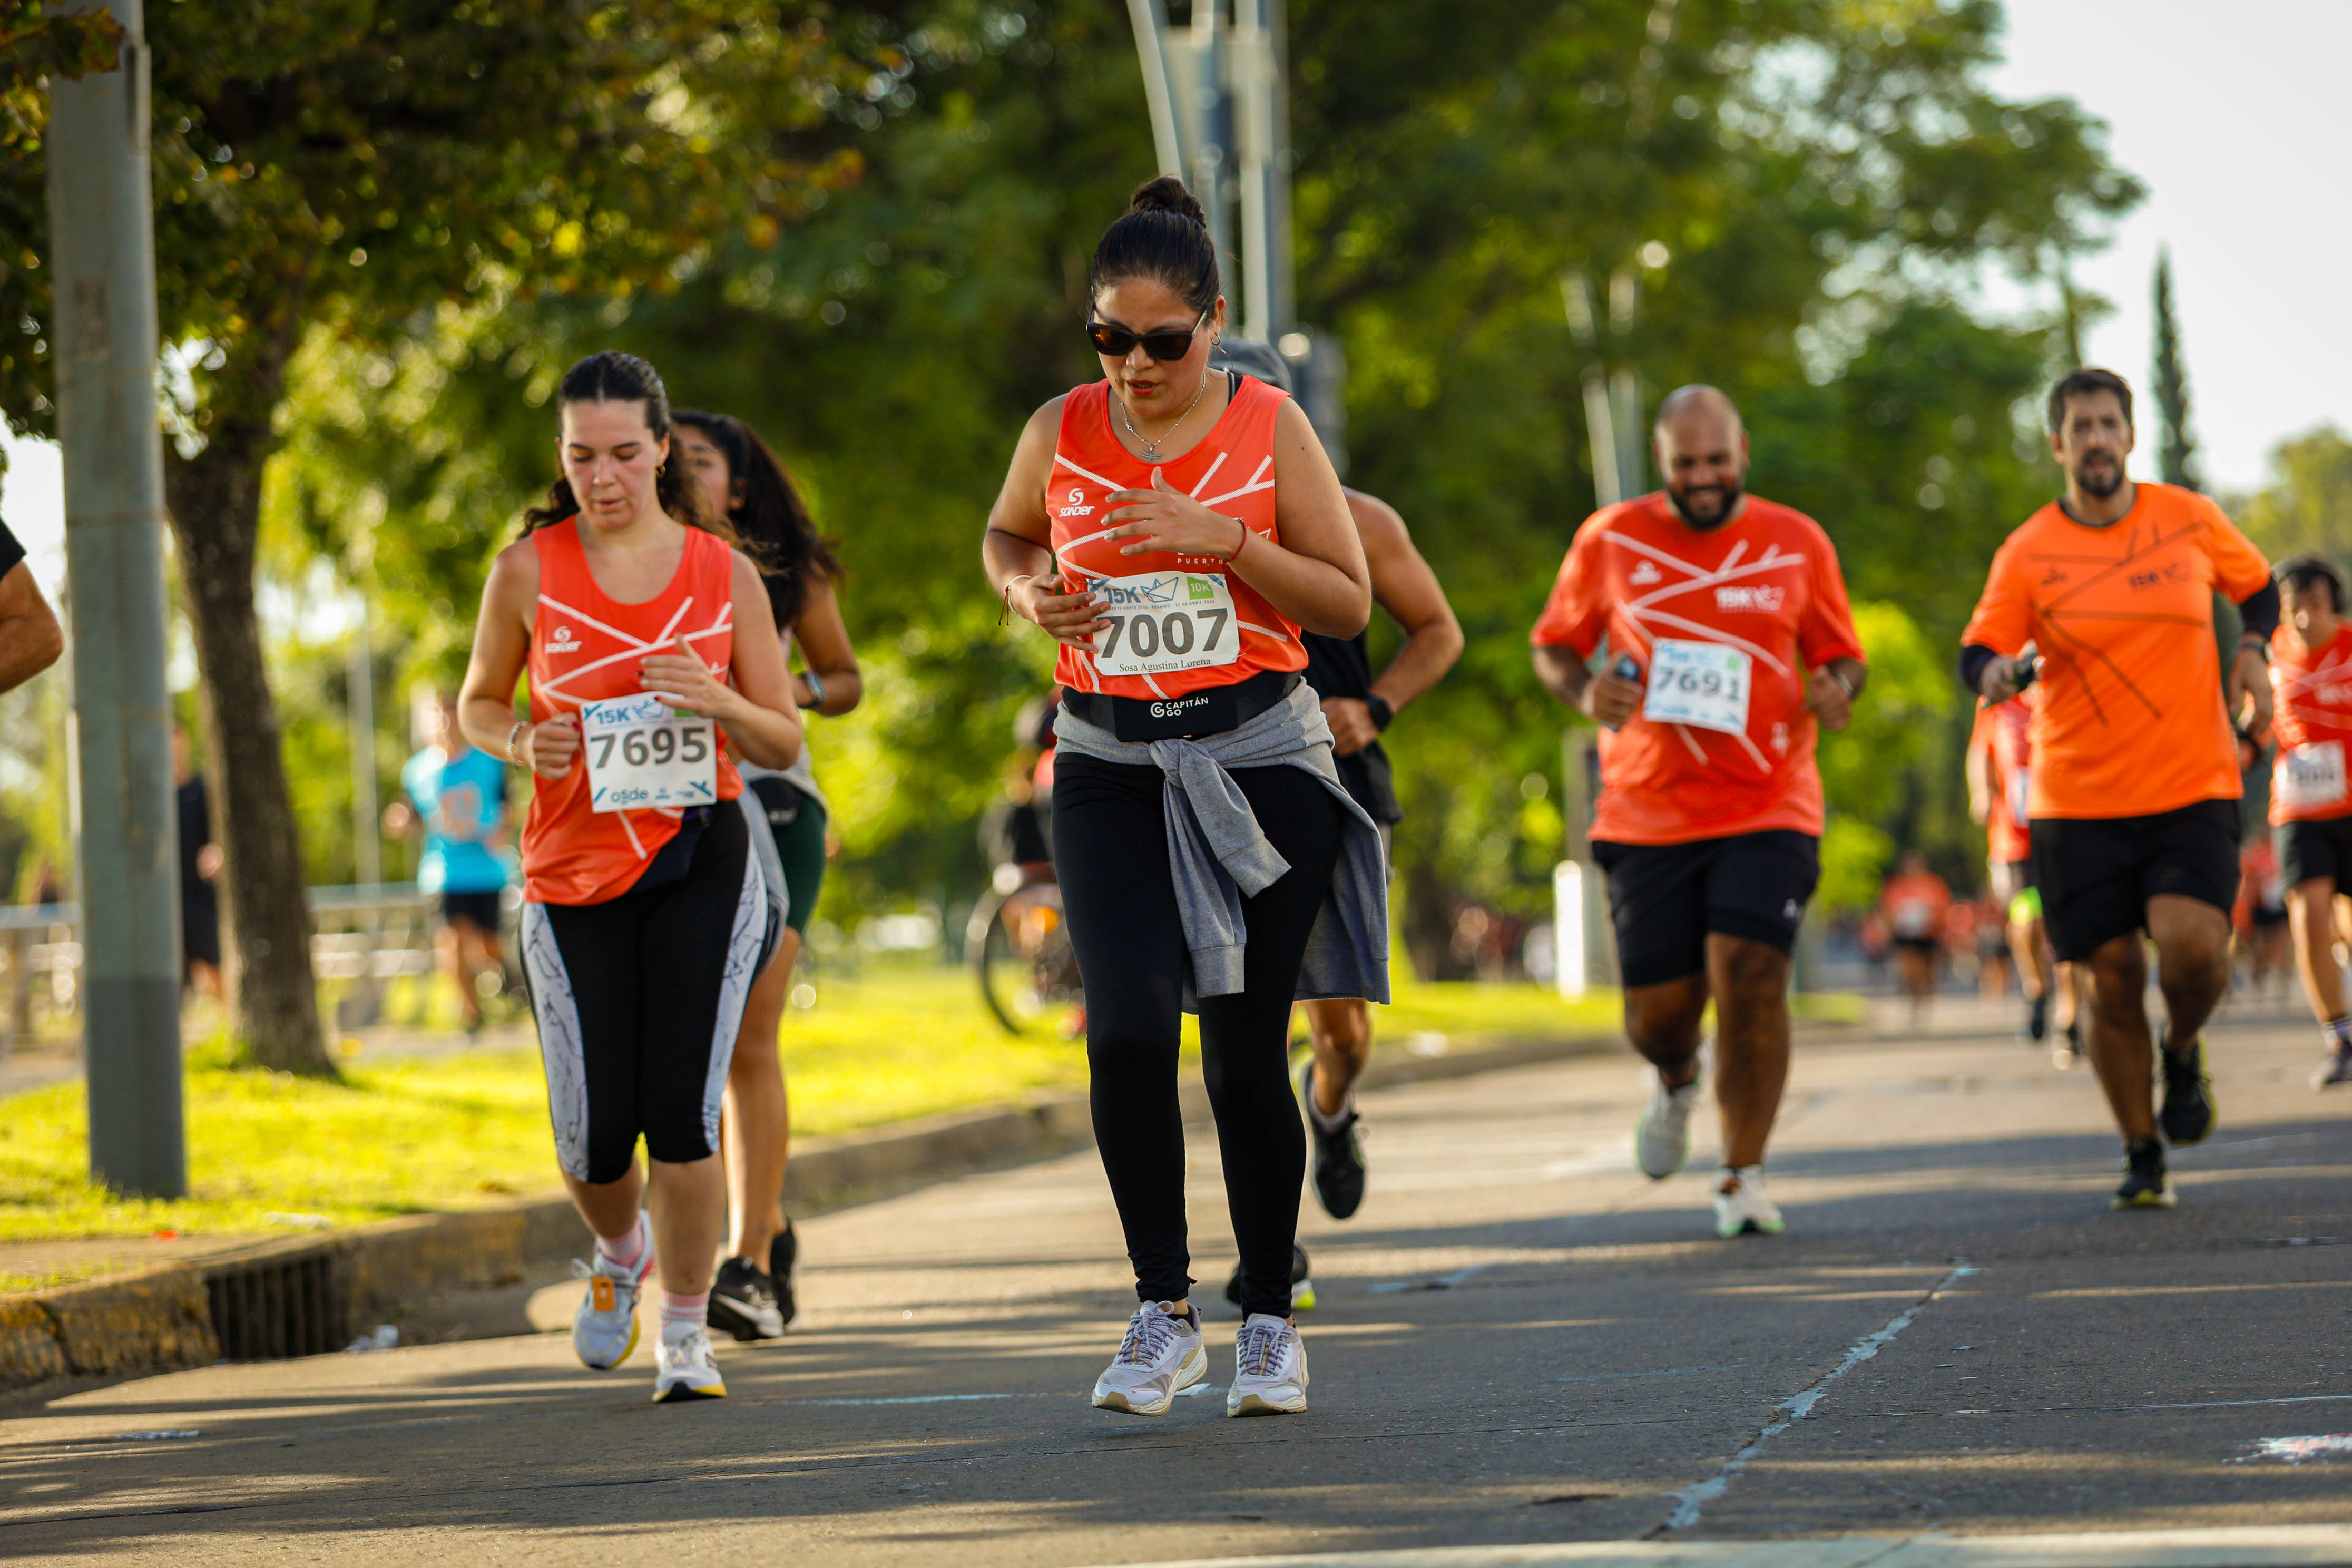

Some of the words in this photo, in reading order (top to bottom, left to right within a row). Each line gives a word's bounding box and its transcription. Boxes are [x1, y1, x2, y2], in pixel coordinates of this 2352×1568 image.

[1104, 586, 1141, 604] 15K
[1190, 583, 1210, 592] 10K
[1096, 608, 1228, 659] 7007
[1119, 663, 1138, 672] Sosa
[1141, 661, 1178, 673] Agustina
[1181, 659, 1211, 668] Lorena
[1657, 665, 1741, 703] 7691
[1165, 697, 1209, 710] CAPITÁN
[596, 707, 631, 725] 15K
[590, 726, 707, 770] 7695
